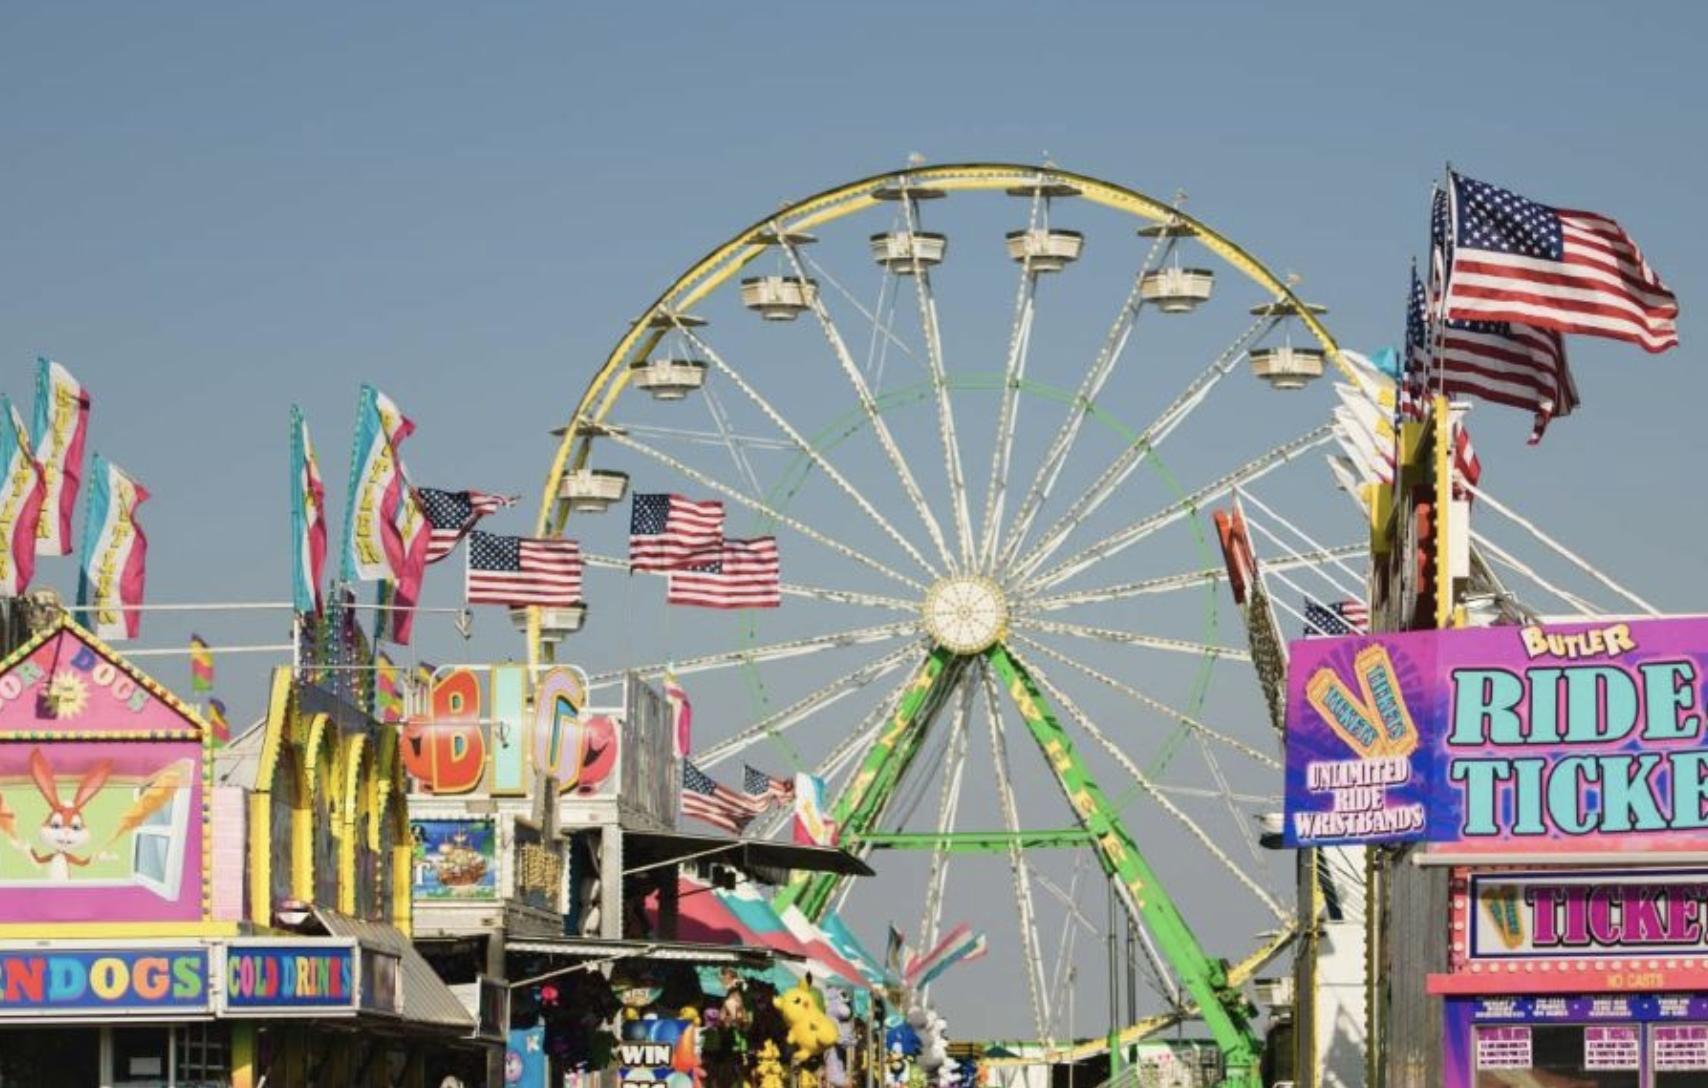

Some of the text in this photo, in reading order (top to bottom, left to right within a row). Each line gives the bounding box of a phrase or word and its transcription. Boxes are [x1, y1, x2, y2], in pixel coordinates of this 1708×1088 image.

[1521, 623, 1638, 660] BUTLER
[70, 645, 150, 713] DOGS
[1447, 660, 1701, 746] RIDE
[431, 664, 587, 797] BIG
[1308, 757, 1410, 791] UNLIMITED
[1295, 804, 1424, 839] WRISTBANDS
[1335, 786, 1385, 813] RIDE
[1525, 883, 1708, 947] TICKE
[0, 956, 201, 1001] NDOGS
[228, 955, 351, 999] COLD DRINKS
[621, 1044, 671, 1065] WIN
